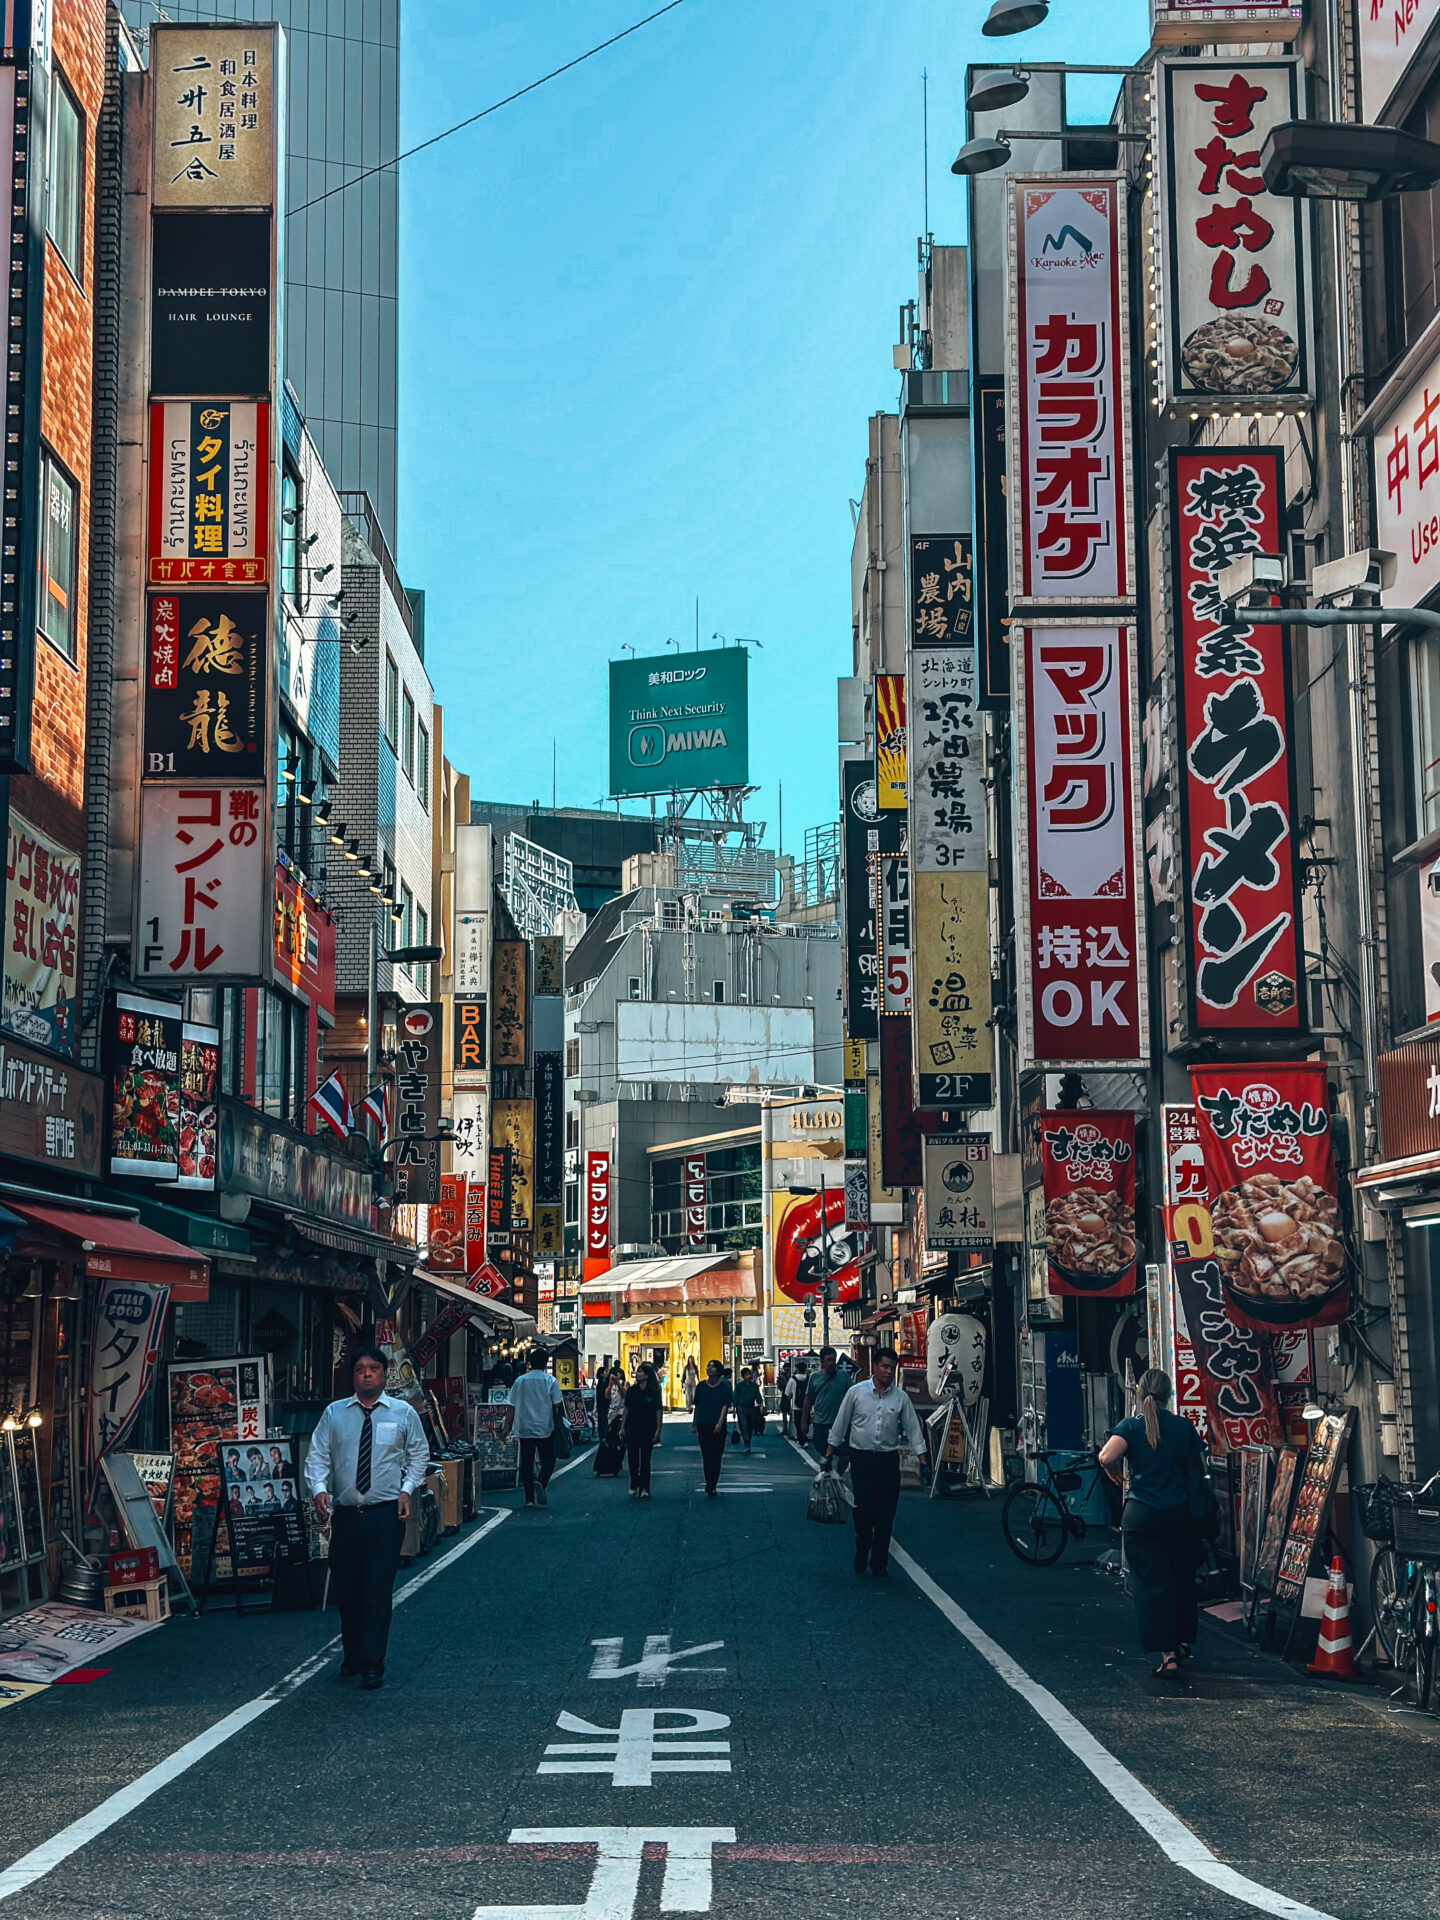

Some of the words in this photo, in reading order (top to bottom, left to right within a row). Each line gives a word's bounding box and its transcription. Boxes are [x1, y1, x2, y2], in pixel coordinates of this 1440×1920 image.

[1393, 0, 1421, 46] Ne
[218, 58, 237, 162] 和食居酒屋
[240, 50, 258, 131] 日本料理
[1194, 74, 1275, 310] すためし
[1030, 256, 1078, 271] Karaoke
[1079, 250, 1105, 270] Mac
[157, 286, 214, 298] DAMDEE
[220, 286, 267, 298] TOKYO
[168, 312, 198, 322] HAIR
[206, 312, 253, 322] LOUNGE
[1033, 312, 1110, 580] カラオケ
[1387, 387, 1440, 516] 中古
[194, 435, 224, 552] タイ料理
[915, 541, 930, 551] 4F
[157, 561, 258, 578] ガパオ食堂
[943, 540, 972, 603] 山内
[915, 571, 949, 639] 農場
[153, 599, 176, 686] 炭火焼肉
[648, 667, 707, 686] 美和ロック
[921, 657, 975, 675] 北海道
[922, 677, 974, 690] シントク町
[629, 706, 658, 721] Think
[660, 705, 683, 718] Next
[685, 700, 726, 715] Security
[666, 727, 728, 753] MIWA
[1040, 643, 1114, 833] マック
[148, 752, 177, 772] B1
[228, 790, 259, 847] 靴の
[935, 844, 966, 867] 3F
[169, 790, 225, 971] コンドル
[143, 916, 165, 972] 1F
[1038, 924, 1131, 970] 持込
[1040, 979, 1131, 1028] OK
[461, 1004, 481, 1064] BAR
[130, 1045, 178, 1073] 食べ放題
[397, 1039, 428, 1166] やきとん
[935, 1074, 974, 1098] 2F
[1198, 1087, 1329, 1140] すためし
[455, 1117, 475, 1158] 伊吹
[966, 1146, 987, 1161] B1
[1044, 1126, 1132, 1163] すためし
[490, 1153, 504, 1197] THREE
[466, 1188, 484, 1242] 立呑み
[490, 1199, 503, 1226] Bar
[590, 1159, 608, 1250] アラジン
[934, 1206, 981, 1229] 奥村
[946, 1195, 972, 1204] たんや
[493, 1233, 508, 1243] Bar
[512, 1218, 528, 1228] 5F
[108, 1305, 143, 1318] FOOD
[113, 1293, 145, 1306] THAI
[241, 1406, 259, 1439] 炭火
[472, 1632, 737, 1920] 止まれ
